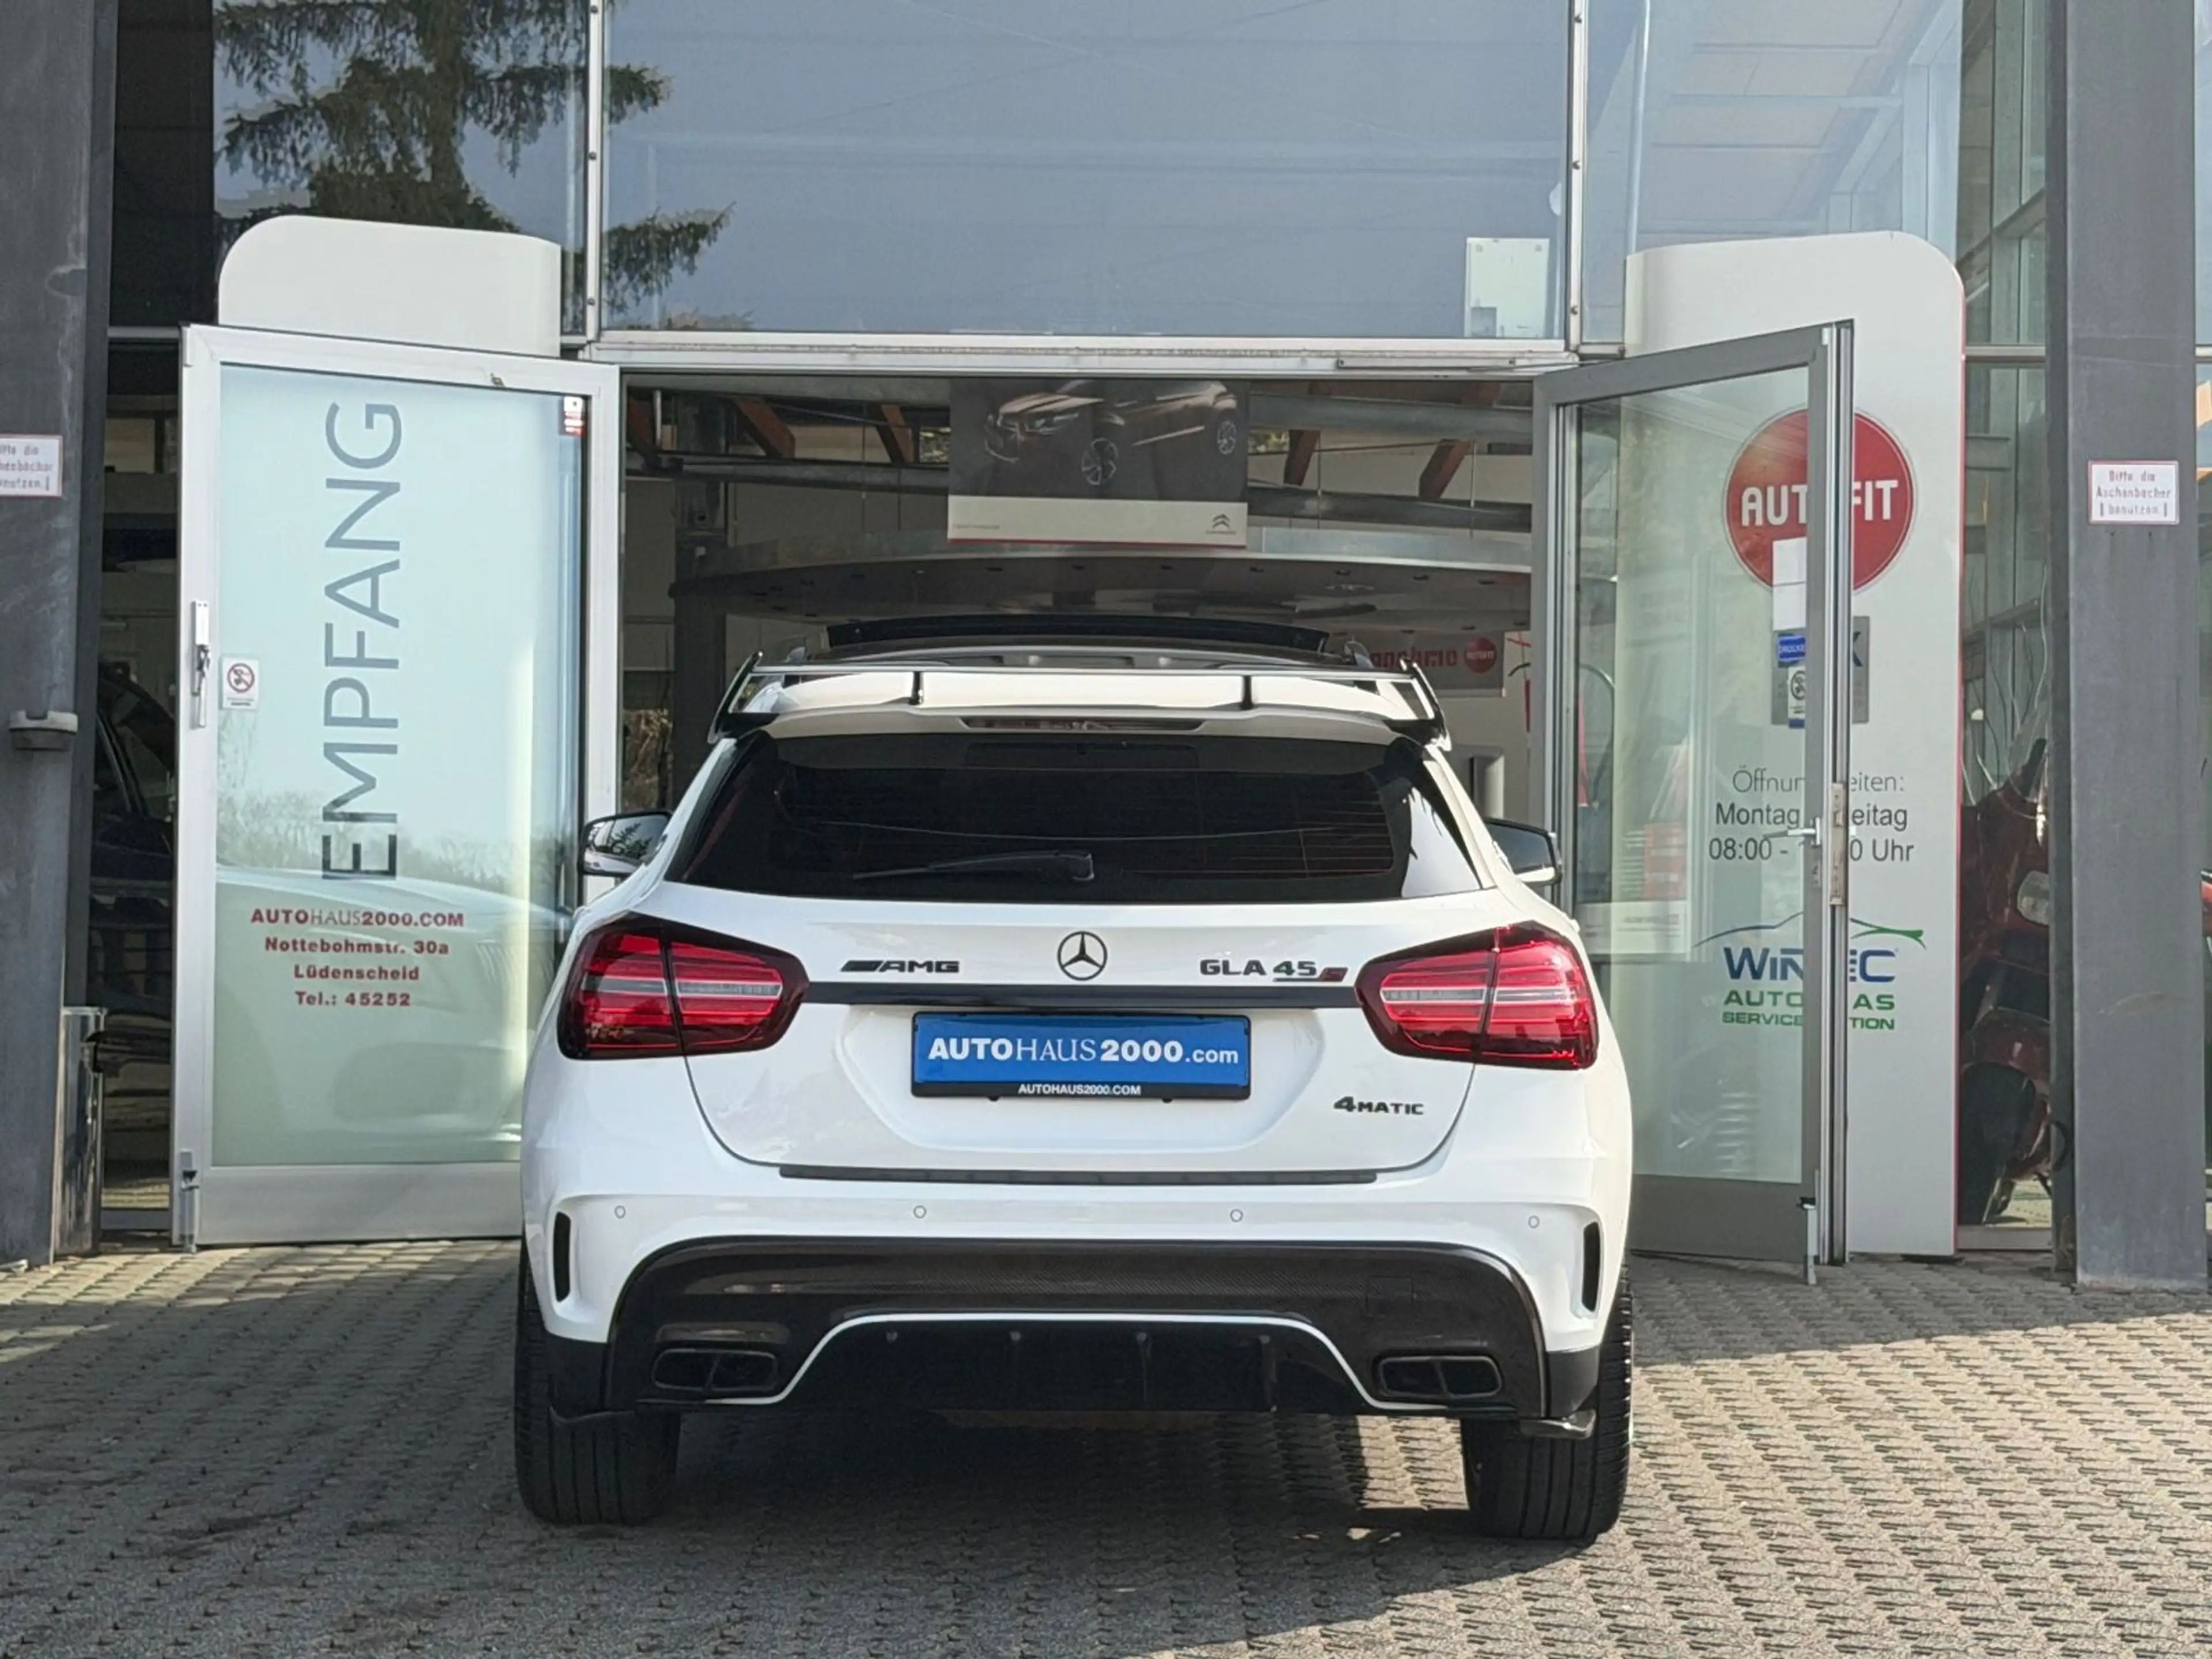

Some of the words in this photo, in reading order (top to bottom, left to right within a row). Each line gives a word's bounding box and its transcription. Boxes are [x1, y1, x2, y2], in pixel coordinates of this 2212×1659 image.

[1741, 479, 1899, 527] AUTFIT
[321, 401, 402, 880] EMPFANG
[1715, 802, 1800, 830] Montag
[1709, 837, 1772, 861] 08:00
[1872, 839, 1915, 862] Uhr
[251, 908, 465, 927] AUTOHAUS2000.COM
[264, 936, 406, 955] Nottebohmstr.
[413, 940, 450, 955] 30a
[293, 963, 421, 981] Lüdenscheid
[878, 960, 960, 974] AMG
[1199, 959, 1267, 976] GLA
[1272, 960, 1317, 976] 45
[294, 990, 338, 1006] Tel.:
[345, 991, 412, 1007] 45252
[1017, 1082, 1142, 1096] AUTOHAUS2000.COM
[1333, 1096, 1425, 1116] 4MATIC
